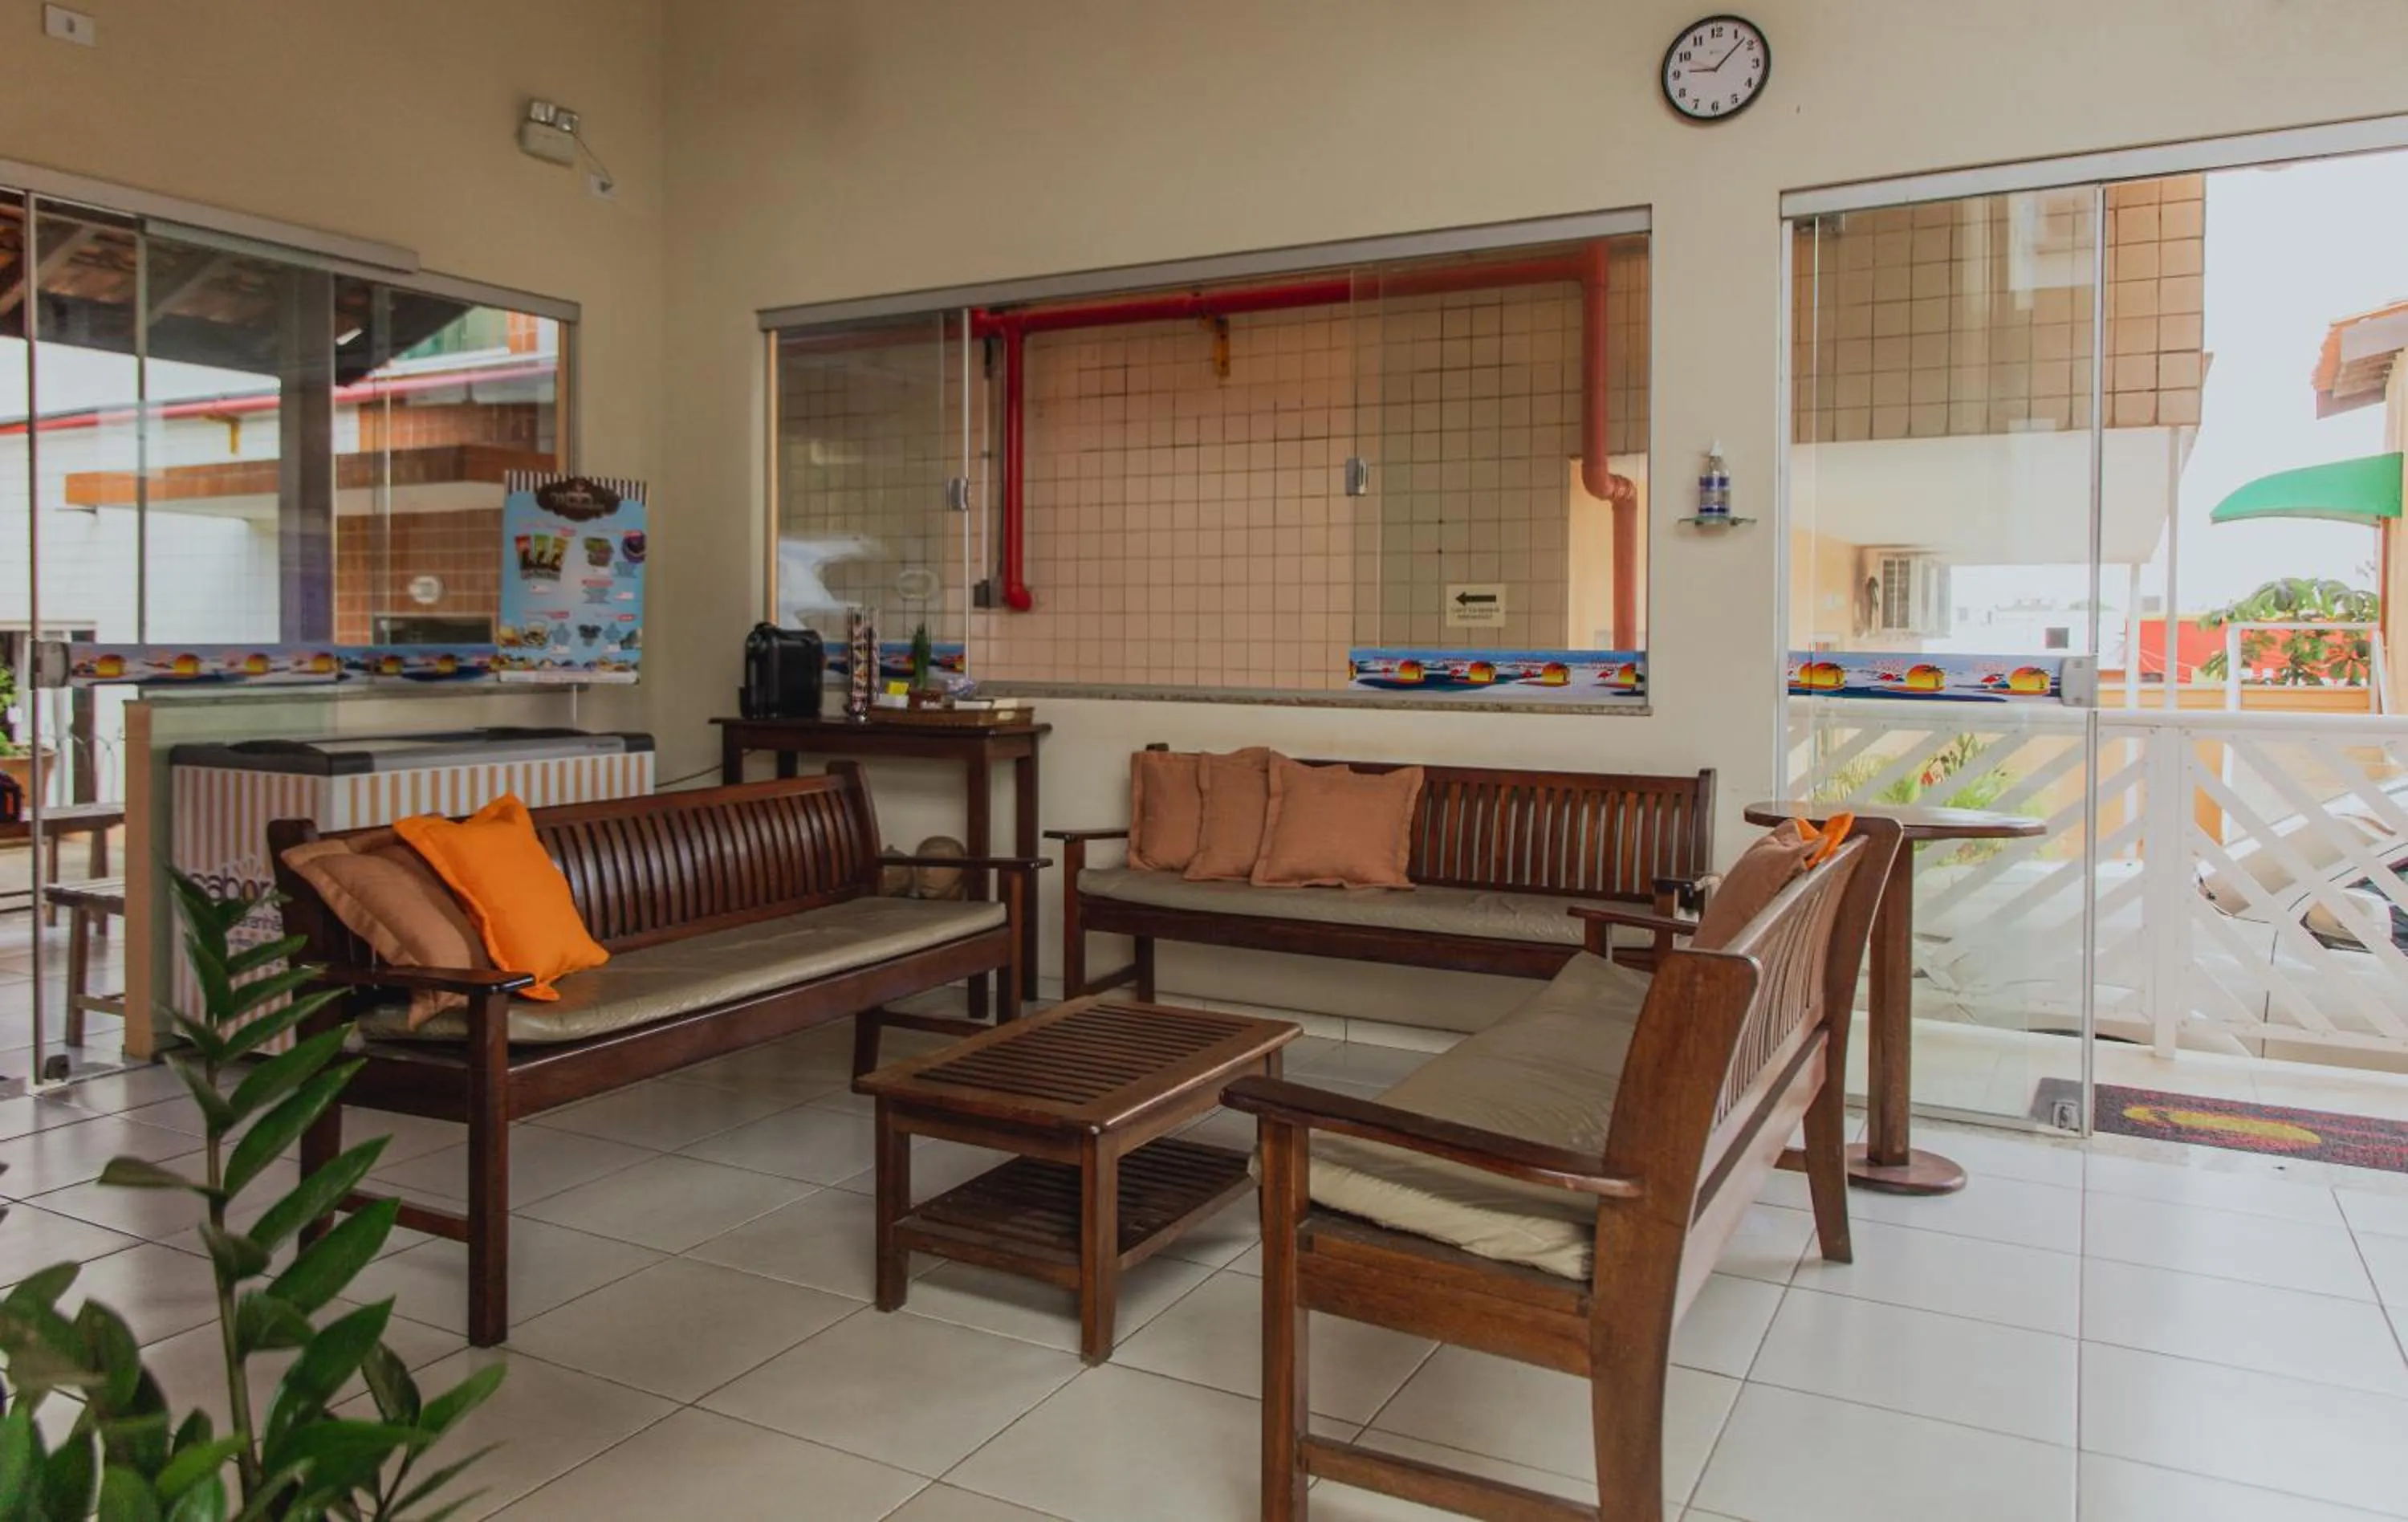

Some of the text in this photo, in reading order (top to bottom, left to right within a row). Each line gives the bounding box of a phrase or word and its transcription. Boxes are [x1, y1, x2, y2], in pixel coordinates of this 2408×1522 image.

[1710, 26, 1723, 39] 12
[1733, 28, 1739, 39] 1
[1693, 35, 1703, 47] 11
[1746, 40, 1754, 51] 2
[1679, 51, 1691, 63] 10
[1752, 58, 1759, 69] 3
[1672, 70, 1681, 80] 9
[1745, 77, 1752, 88] 4
[1678, 87, 1686, 98] 8
[1693, 99, 1699, 109] 7
[1731, 93, 1739, 104] 5
[1711, 101, 1719, 112] 6
